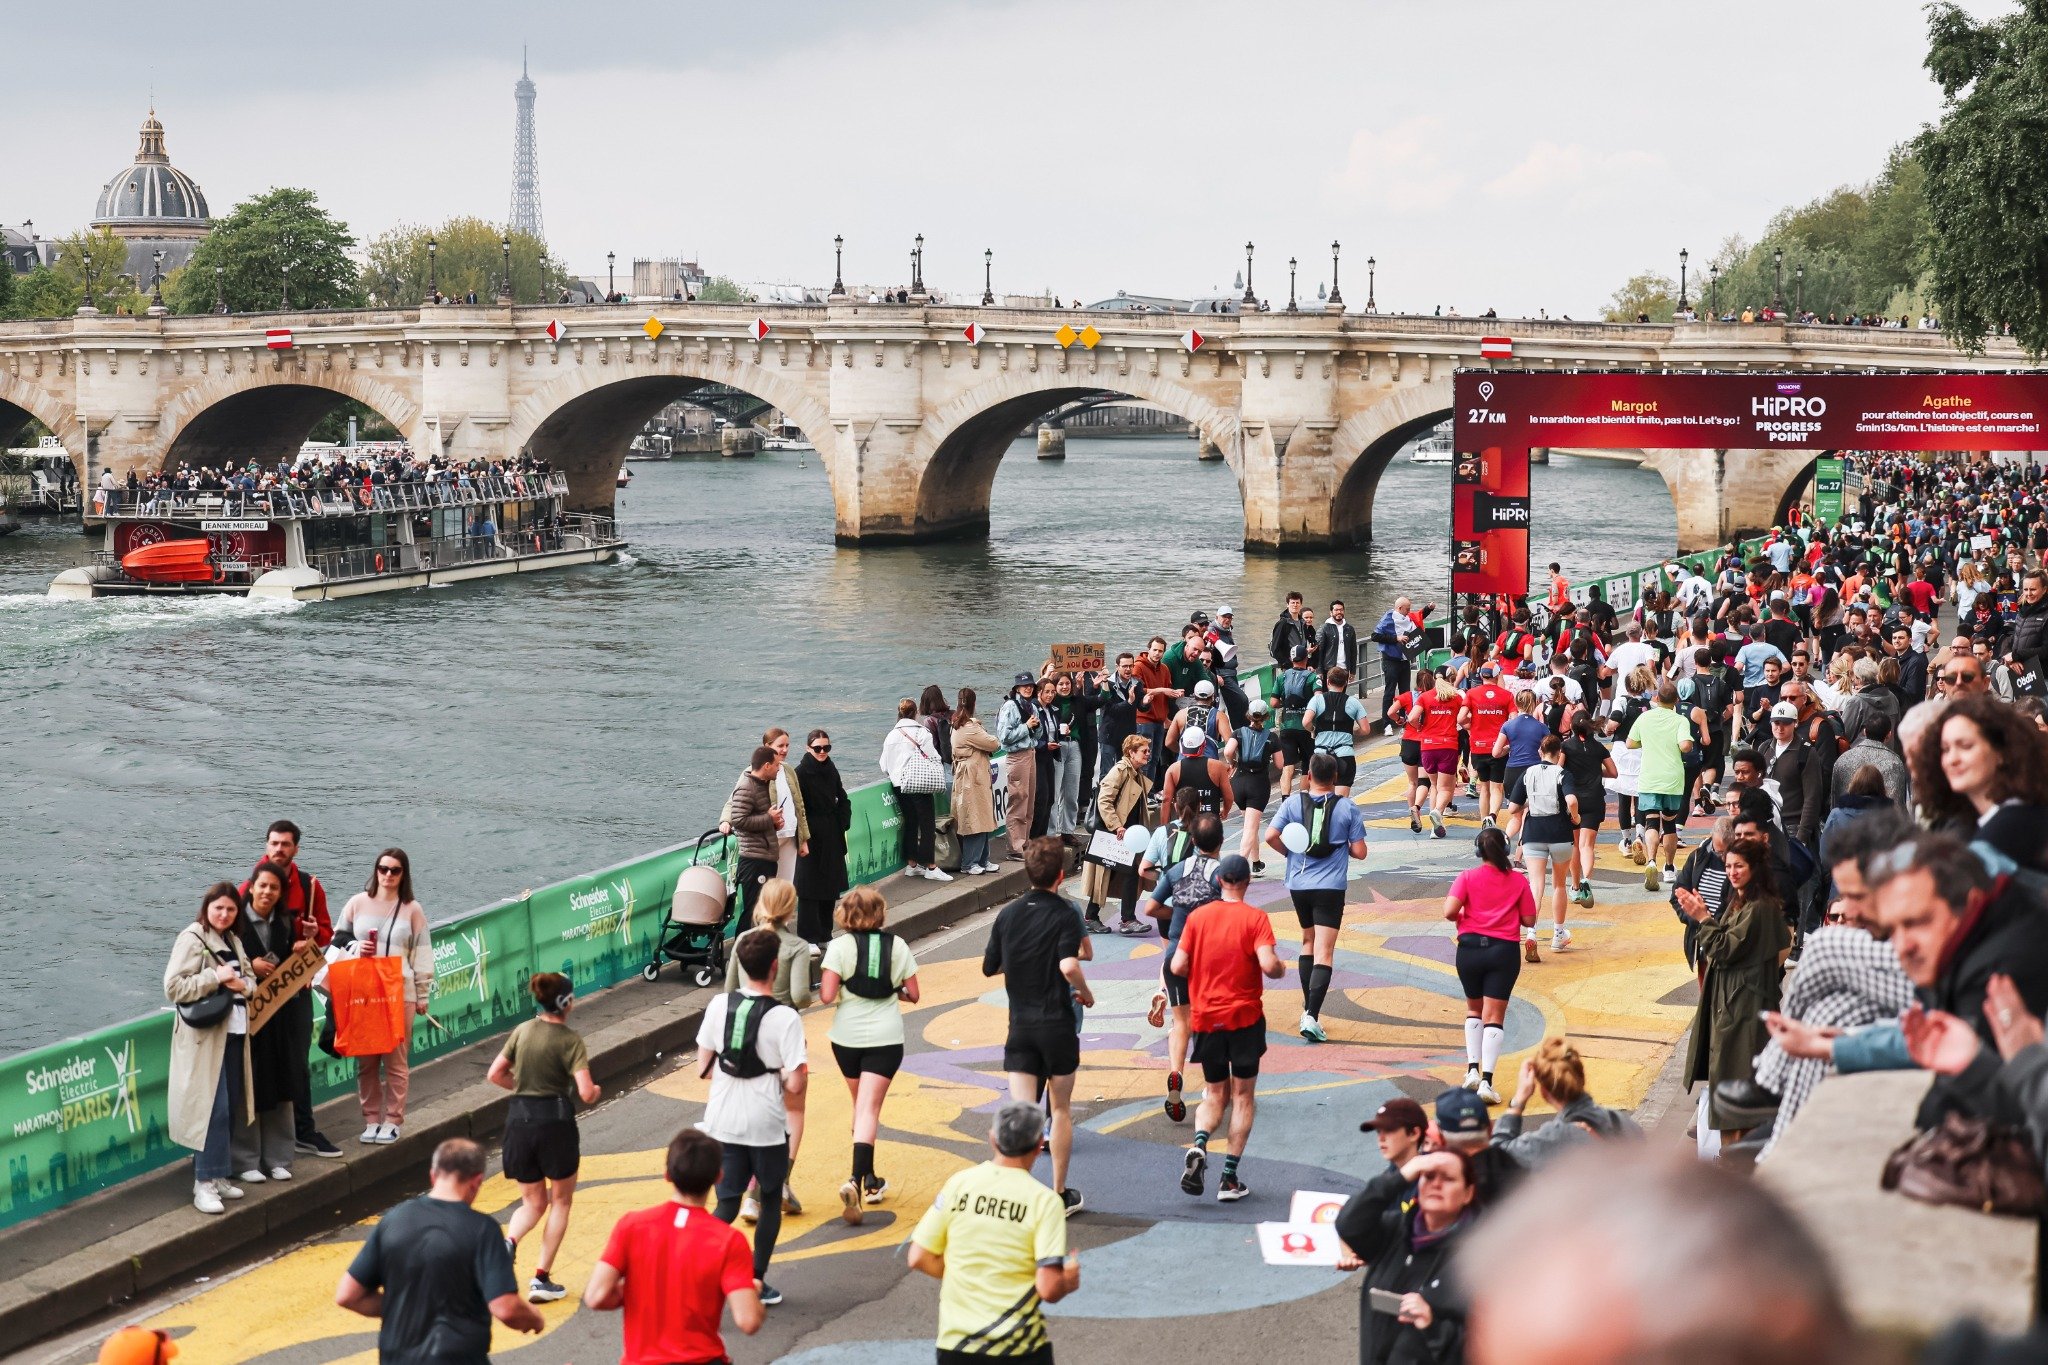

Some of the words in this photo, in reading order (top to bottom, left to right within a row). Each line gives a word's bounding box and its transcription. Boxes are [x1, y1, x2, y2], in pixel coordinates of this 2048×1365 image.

[1612, 400, 1658, 414] Margot
[1752, 396, 1826, 416] HiPRO
[1922, 395, 1972, 409] Agathe
[1530, 415, 1538, 424] le
[1540, 415, 1584, 424] marathon
[1586, 415, 1600, 424] est
[1602, 414, 1635, 424] bientôt
[1636, 415, 1663, 426] finito,
[1664, 417, 1681, 426] pas
[1682, 415, 1698, 424] toi.
[1862, 412, 1886, 421] pour
[1886, 411, 1930, 420] atteindre
[1932, 412, 1948, 420] ton
[1950, 411, 1990, 421] objectif,
[1756, 422, 1821, 431] PROGRESS
[1966, 424, 1982, 432] est
[1997, 423, 2034, 432] marche
[1769, 432, 1808, 442] POINT
[1830, 482, 1840, 490] 27
[570, 887, 609, 911] Schneider
[590, 904, 612, 918] Electric
[562, 924, 590, 941] MARATHON
[590, 917, 616, 938] PARIS
[435, 958, 462, 974] Electric
[439, 969, 469, 997] PARIS
[26, 1055, 96, 1095] Schneider
[60, 1079, 98, 1100] Electric
[64, 1093, 112, 1131] PARIS
[14, 1108, 63, 1138] MARATHON
[974, 1195, 1027, 1223] CREW
